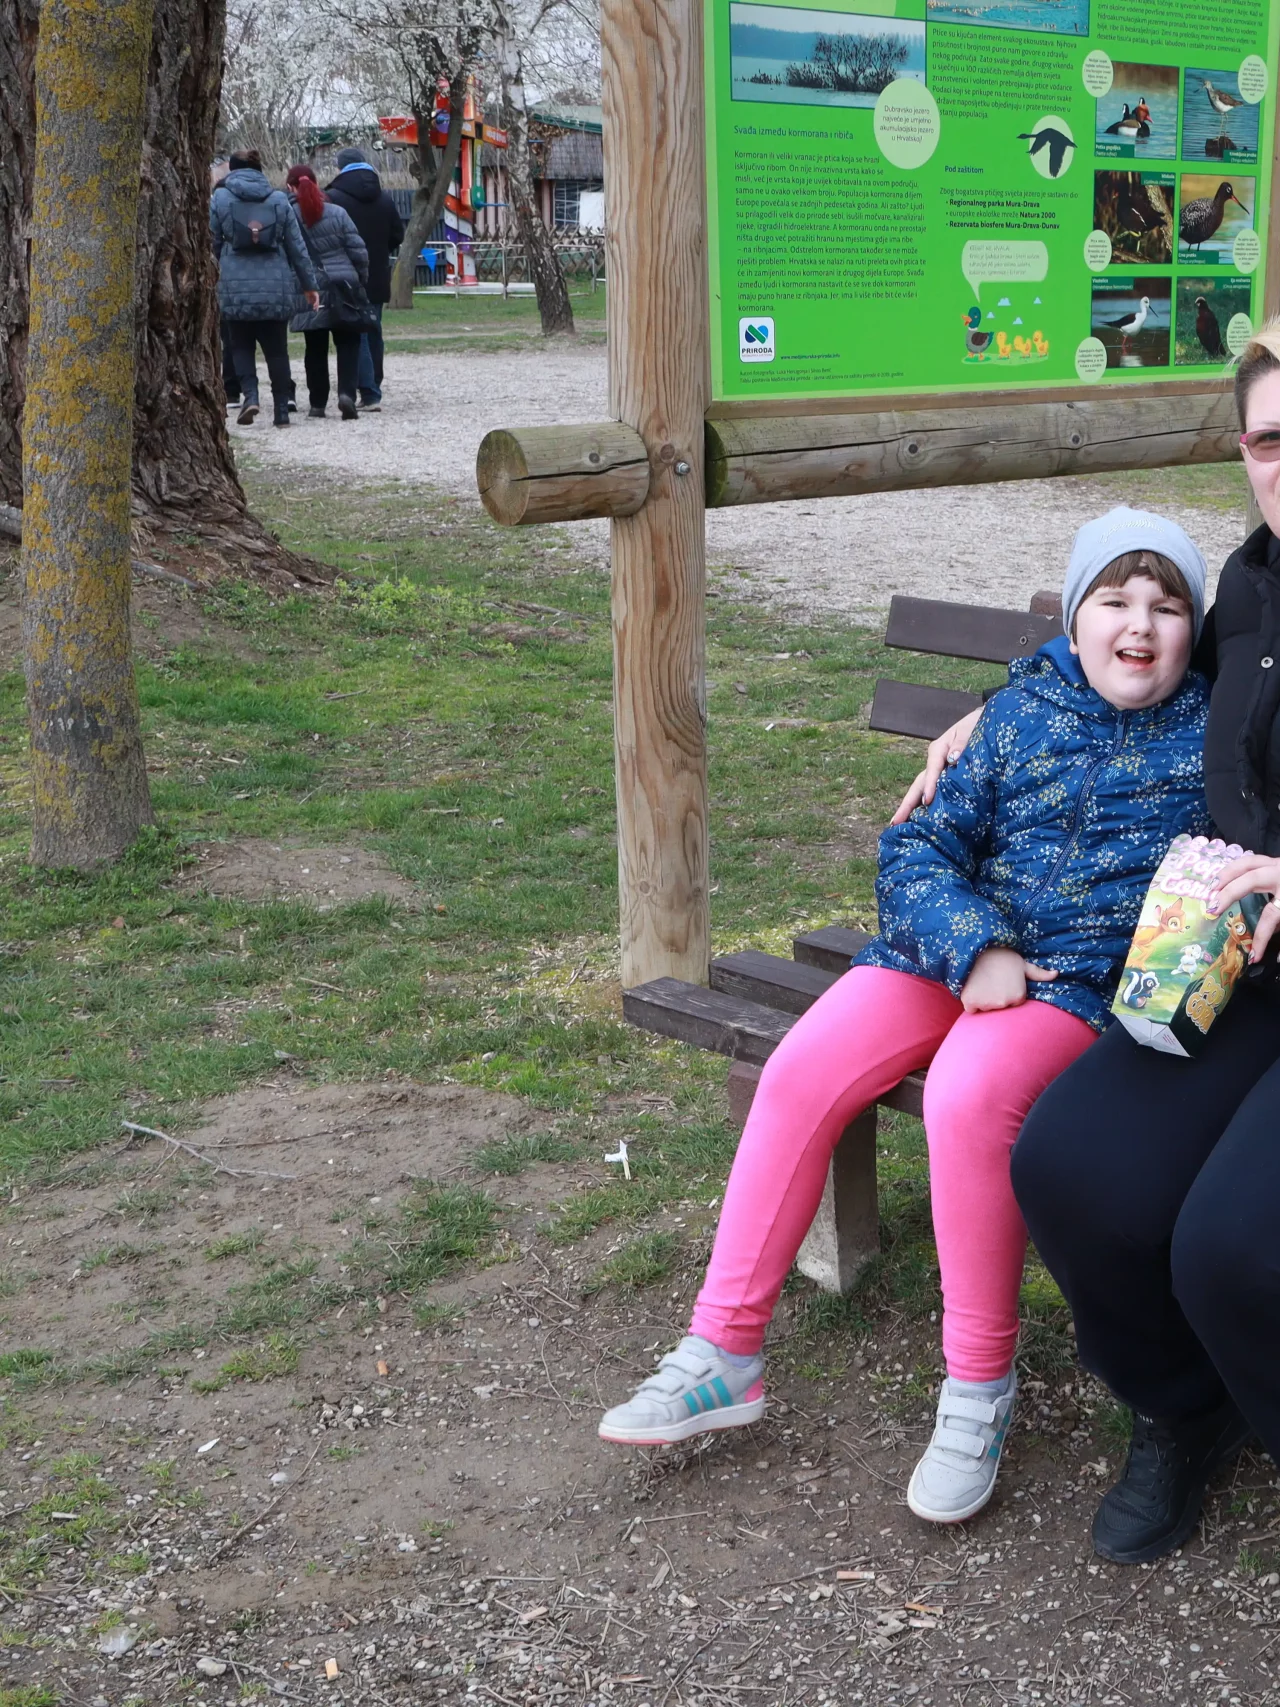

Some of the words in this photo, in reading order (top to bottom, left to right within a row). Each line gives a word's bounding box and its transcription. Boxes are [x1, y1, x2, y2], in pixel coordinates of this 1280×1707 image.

[734, 126, 757, 135] Svađa
[759, 127, 787, 136] između
[788, 128, 829, 138] kormorana
[834, 130, 854, 139] ribiča
[735, 151, 768, 159] Kormoran
[824, 154, 840, 163] ptica
[842, 154, 855, 164] koja
[735, 163, 766, 172] isključivo
[800, 165, 812, 174] nije
[814, 165, 843, 173] invazivna
[958, 165, 984, 174] zaštitom
[792, 176, 805, 186] koja
[814, 177, 832, 186] uvijek
[834, 178, 862, 186] obitavala
[891, 179, 918, 188] području,
[818, 188, 835, 198] broju.
[838, 189, 869, 198] Populacija
[871, 190, 904, 198] kormorana
[905, 190, 923, 200] diljem
[736, 199, 760, 208] Europe
[761, 199, 790, 208] povećala
[800, 200, 823, 209] zadnjih
[824, 200, 856, 210] pedesetak
[911, 202, 925, 211] Ljudi
[950, 198, 987, 208] Regionalnog
[988, 199, 1005, 208] parka
[1006, 200, 1040, 208] Mura-Drava
[746, 211, 778, 220] prilagodili
[807, 212, 830, 221] prirode
[865, 212, 891, 222] močvare,
[736, 222, 754, 231] rijeke,
[757, 222, 783, 232] izgradili
[899, 224, 927, 233] preostaje
[754, 234, 774, 243] drugo
[788, 234, 815, 243] potražiti
[846, 235, 874, 244] mjestima
[875, 235, 888, 244] gdje
[737, 257, 758, 266] riješiti
[868, 258, 889, 266] preleta
[904, 258, 919, 266] ptica
[755, 269, 787, 278] zamijeniti
[843, 269, 865, 278] drugog
[866, 269, 882, 278] dijela
[883, 269, 904, 278] Europe.
[764, 280, 778, 289] ljudi
[738, 292, 757, 301] imaju
